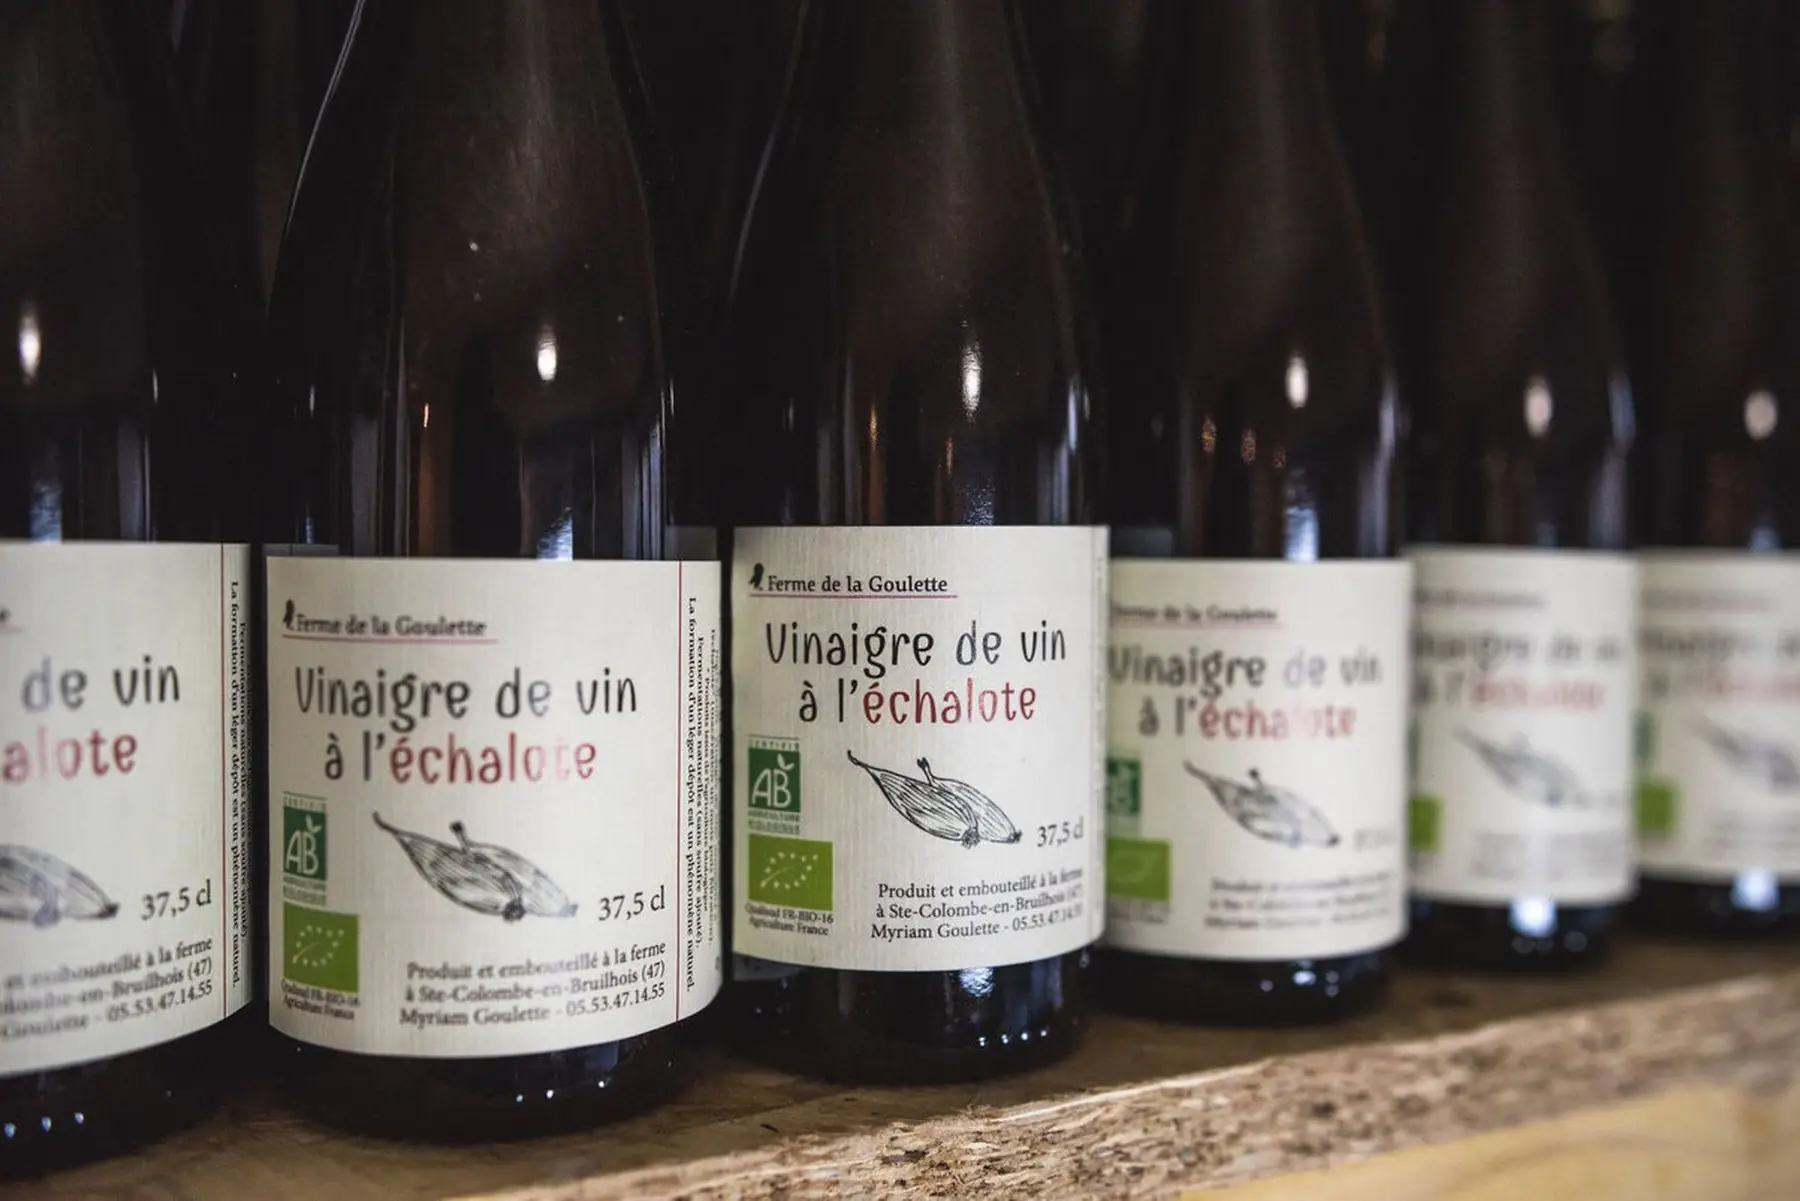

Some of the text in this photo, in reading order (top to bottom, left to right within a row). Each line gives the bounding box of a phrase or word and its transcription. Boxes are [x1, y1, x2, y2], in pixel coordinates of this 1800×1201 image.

[231, 581, 239, 599] La
[767, 575, 948, 593] Ferme de la Goulette
[231, 603, 240, 676] formation
[296, 613, 486, 637] Ferme de la Goulette
[766, 620, 1066, 679] Vinaigre de vin
[21, 654, 180, 714] de vin
[697, 636, 705, 738] Fermentations
[1108, 647, 1267, 699] Vinaigre
[1283, 647, 1327, 689] de
[231, 679, 240, 712] d'un
[295, 665, 637, 733] Vinaigre de vin
[799, 677, 1036, 724] à l'échalote
[230, 714, 240, 749] léger
[230, 753, 240, 795] dépôt
[325, 729, 597, 785] à l'échalote
[696, 741, 704, 808] naturelles
[686, 597, 698, 993] La formation d'un léger dépôt est un phénomène naturel.
[752, 768, 791, 808] AB
[232, 822, 239, 842] un
[1037, 821, 1070, 848] 37,5
[286, 829, 320, 876] AB
[141, 879, 212, 921] 37,5 cl
[230, 845, 240, 930] phénomène
[598, 884, 666, 922] 37,5 cl
[878, 883, 936, 899] Produit
[941, 883, 954, 898] et
[959, 874, 1036, 897] embouteillé
[876, 903, 885, 918] à
[159, 945, 172, 964] la
[176, 938, 213, 960] ferme
[871, 924, 932, 943] Myriam
[937, 922, 999, 939] Goulette
[187, 956, 213, 982] (47)
[407, 942, 666, 980] Produit et embouteillé à la ferme
[642, 959, 666, 983] (47)
[399, 1007, 468, 1031] Myriam
[473, 1005, 550, 1025] Goulette
[565, 981, 666, 1018] 05.53.47.14.55
